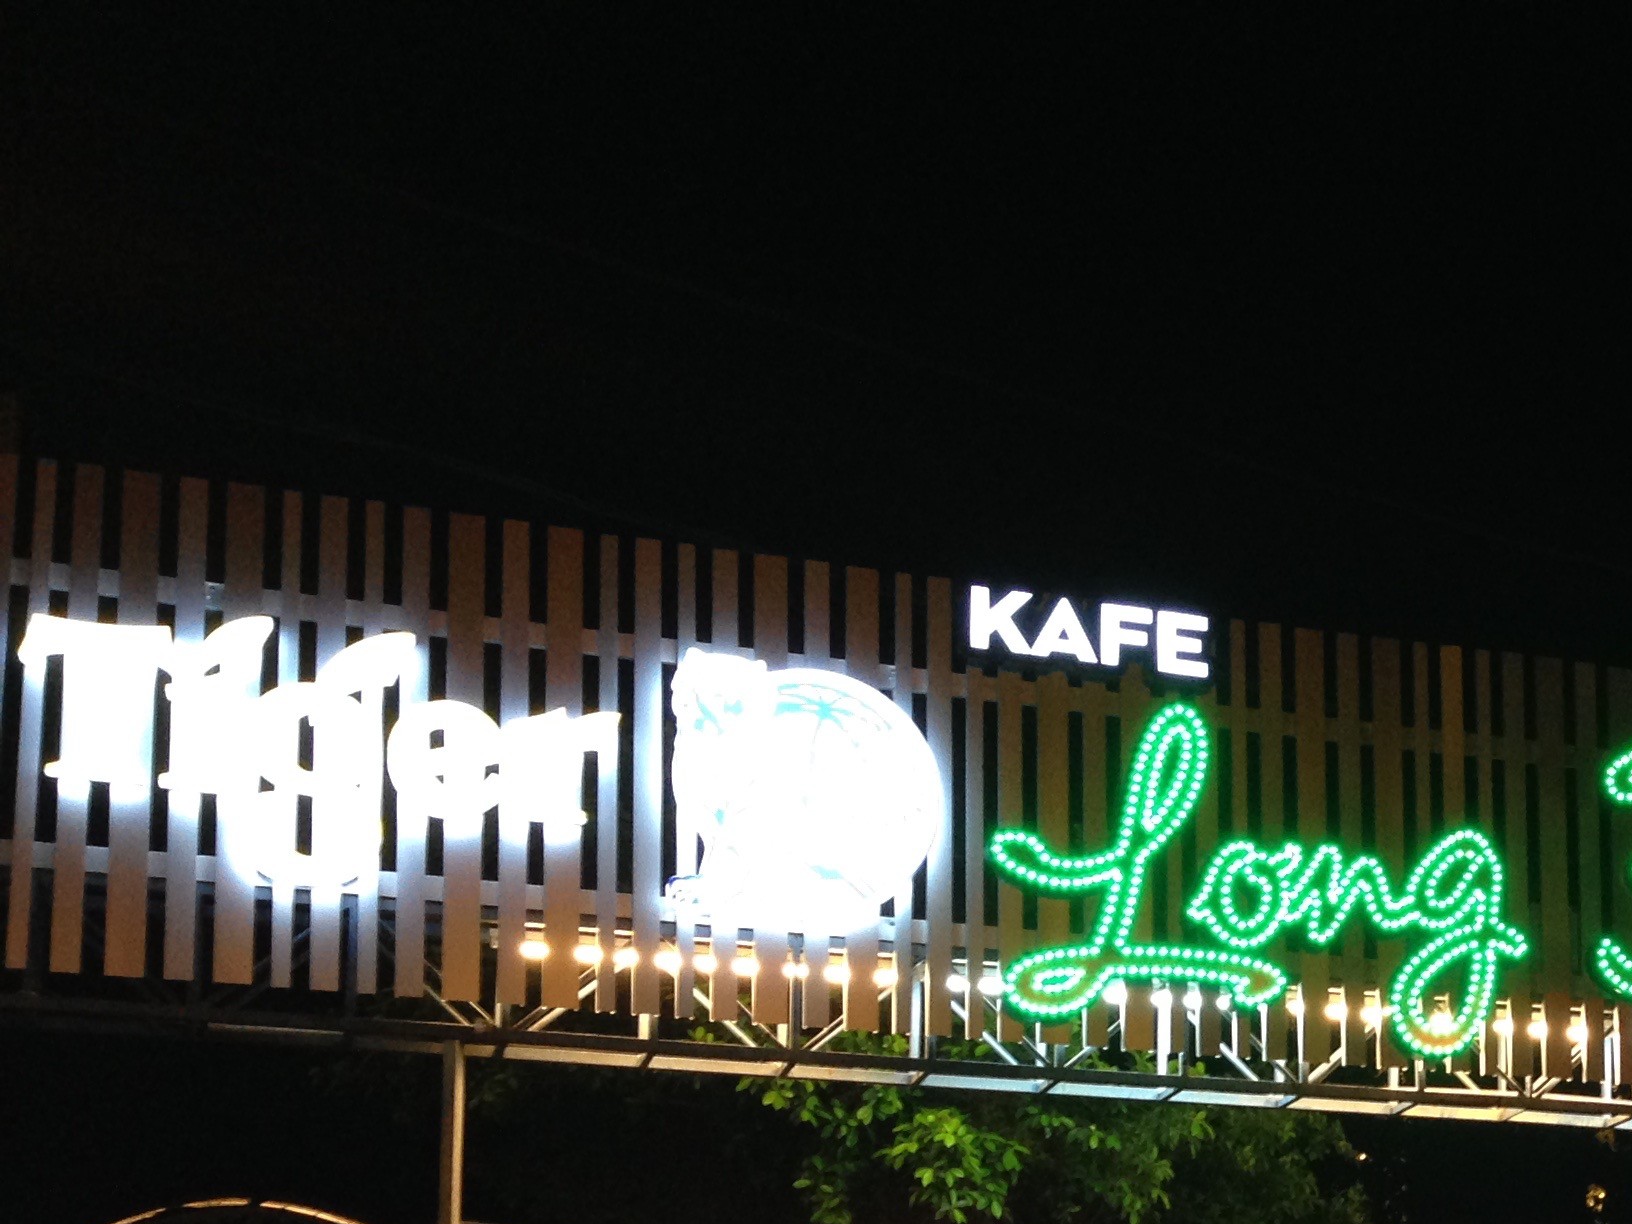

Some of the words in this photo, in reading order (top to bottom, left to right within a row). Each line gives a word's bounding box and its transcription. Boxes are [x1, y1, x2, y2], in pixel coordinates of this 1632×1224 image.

[17, 613, 621, 887] Tiger
[968, 583, 1210, 678] KAFE
[990, 701, 1528, 1058] Long
